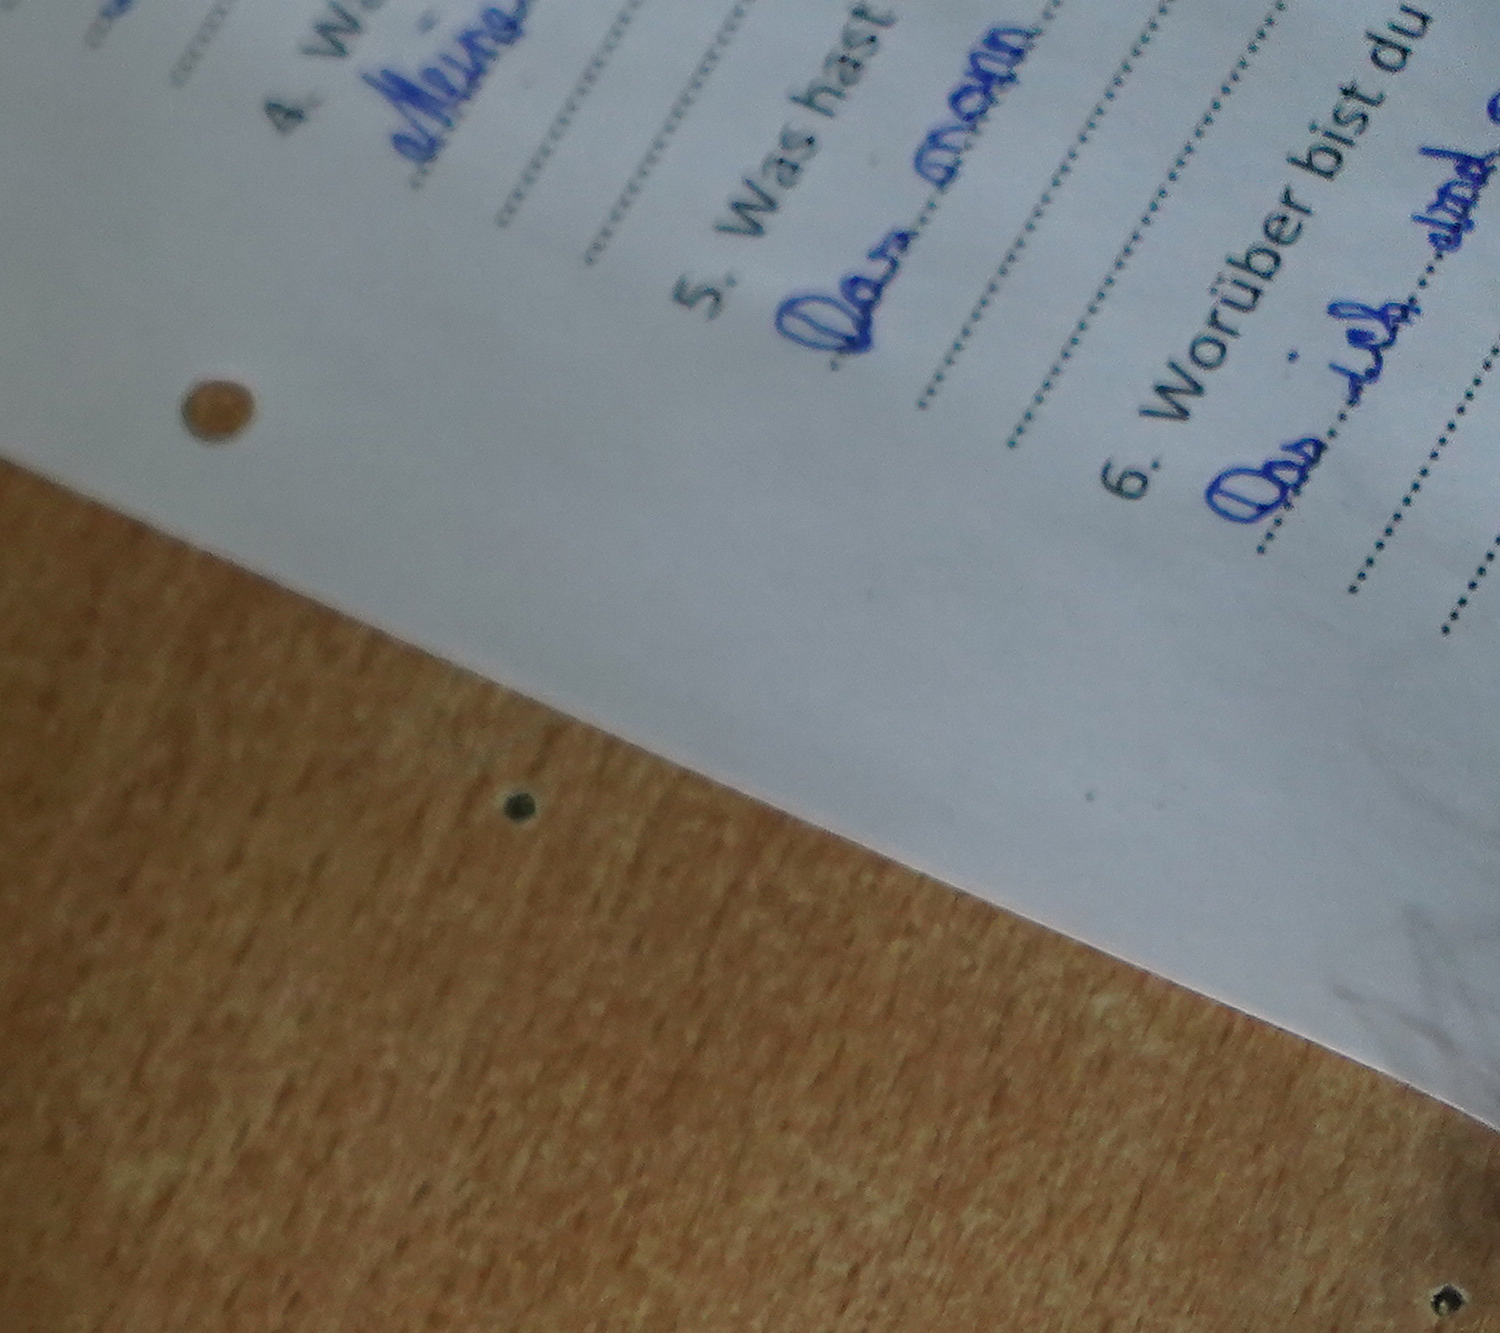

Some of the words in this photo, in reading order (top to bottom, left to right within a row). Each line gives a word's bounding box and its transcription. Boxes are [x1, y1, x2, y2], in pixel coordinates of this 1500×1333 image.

[671, 272, 737, 320] 5.
[713, 121, 820, 238] Was
[788, 2, 897, 118] hast
[1101, 456, 1163, 501] 6.
[1139, 183, 1316, 423] Worüber
[1287, 80, 1387, 182] bist
[1365, 3, 1433, 74] du
